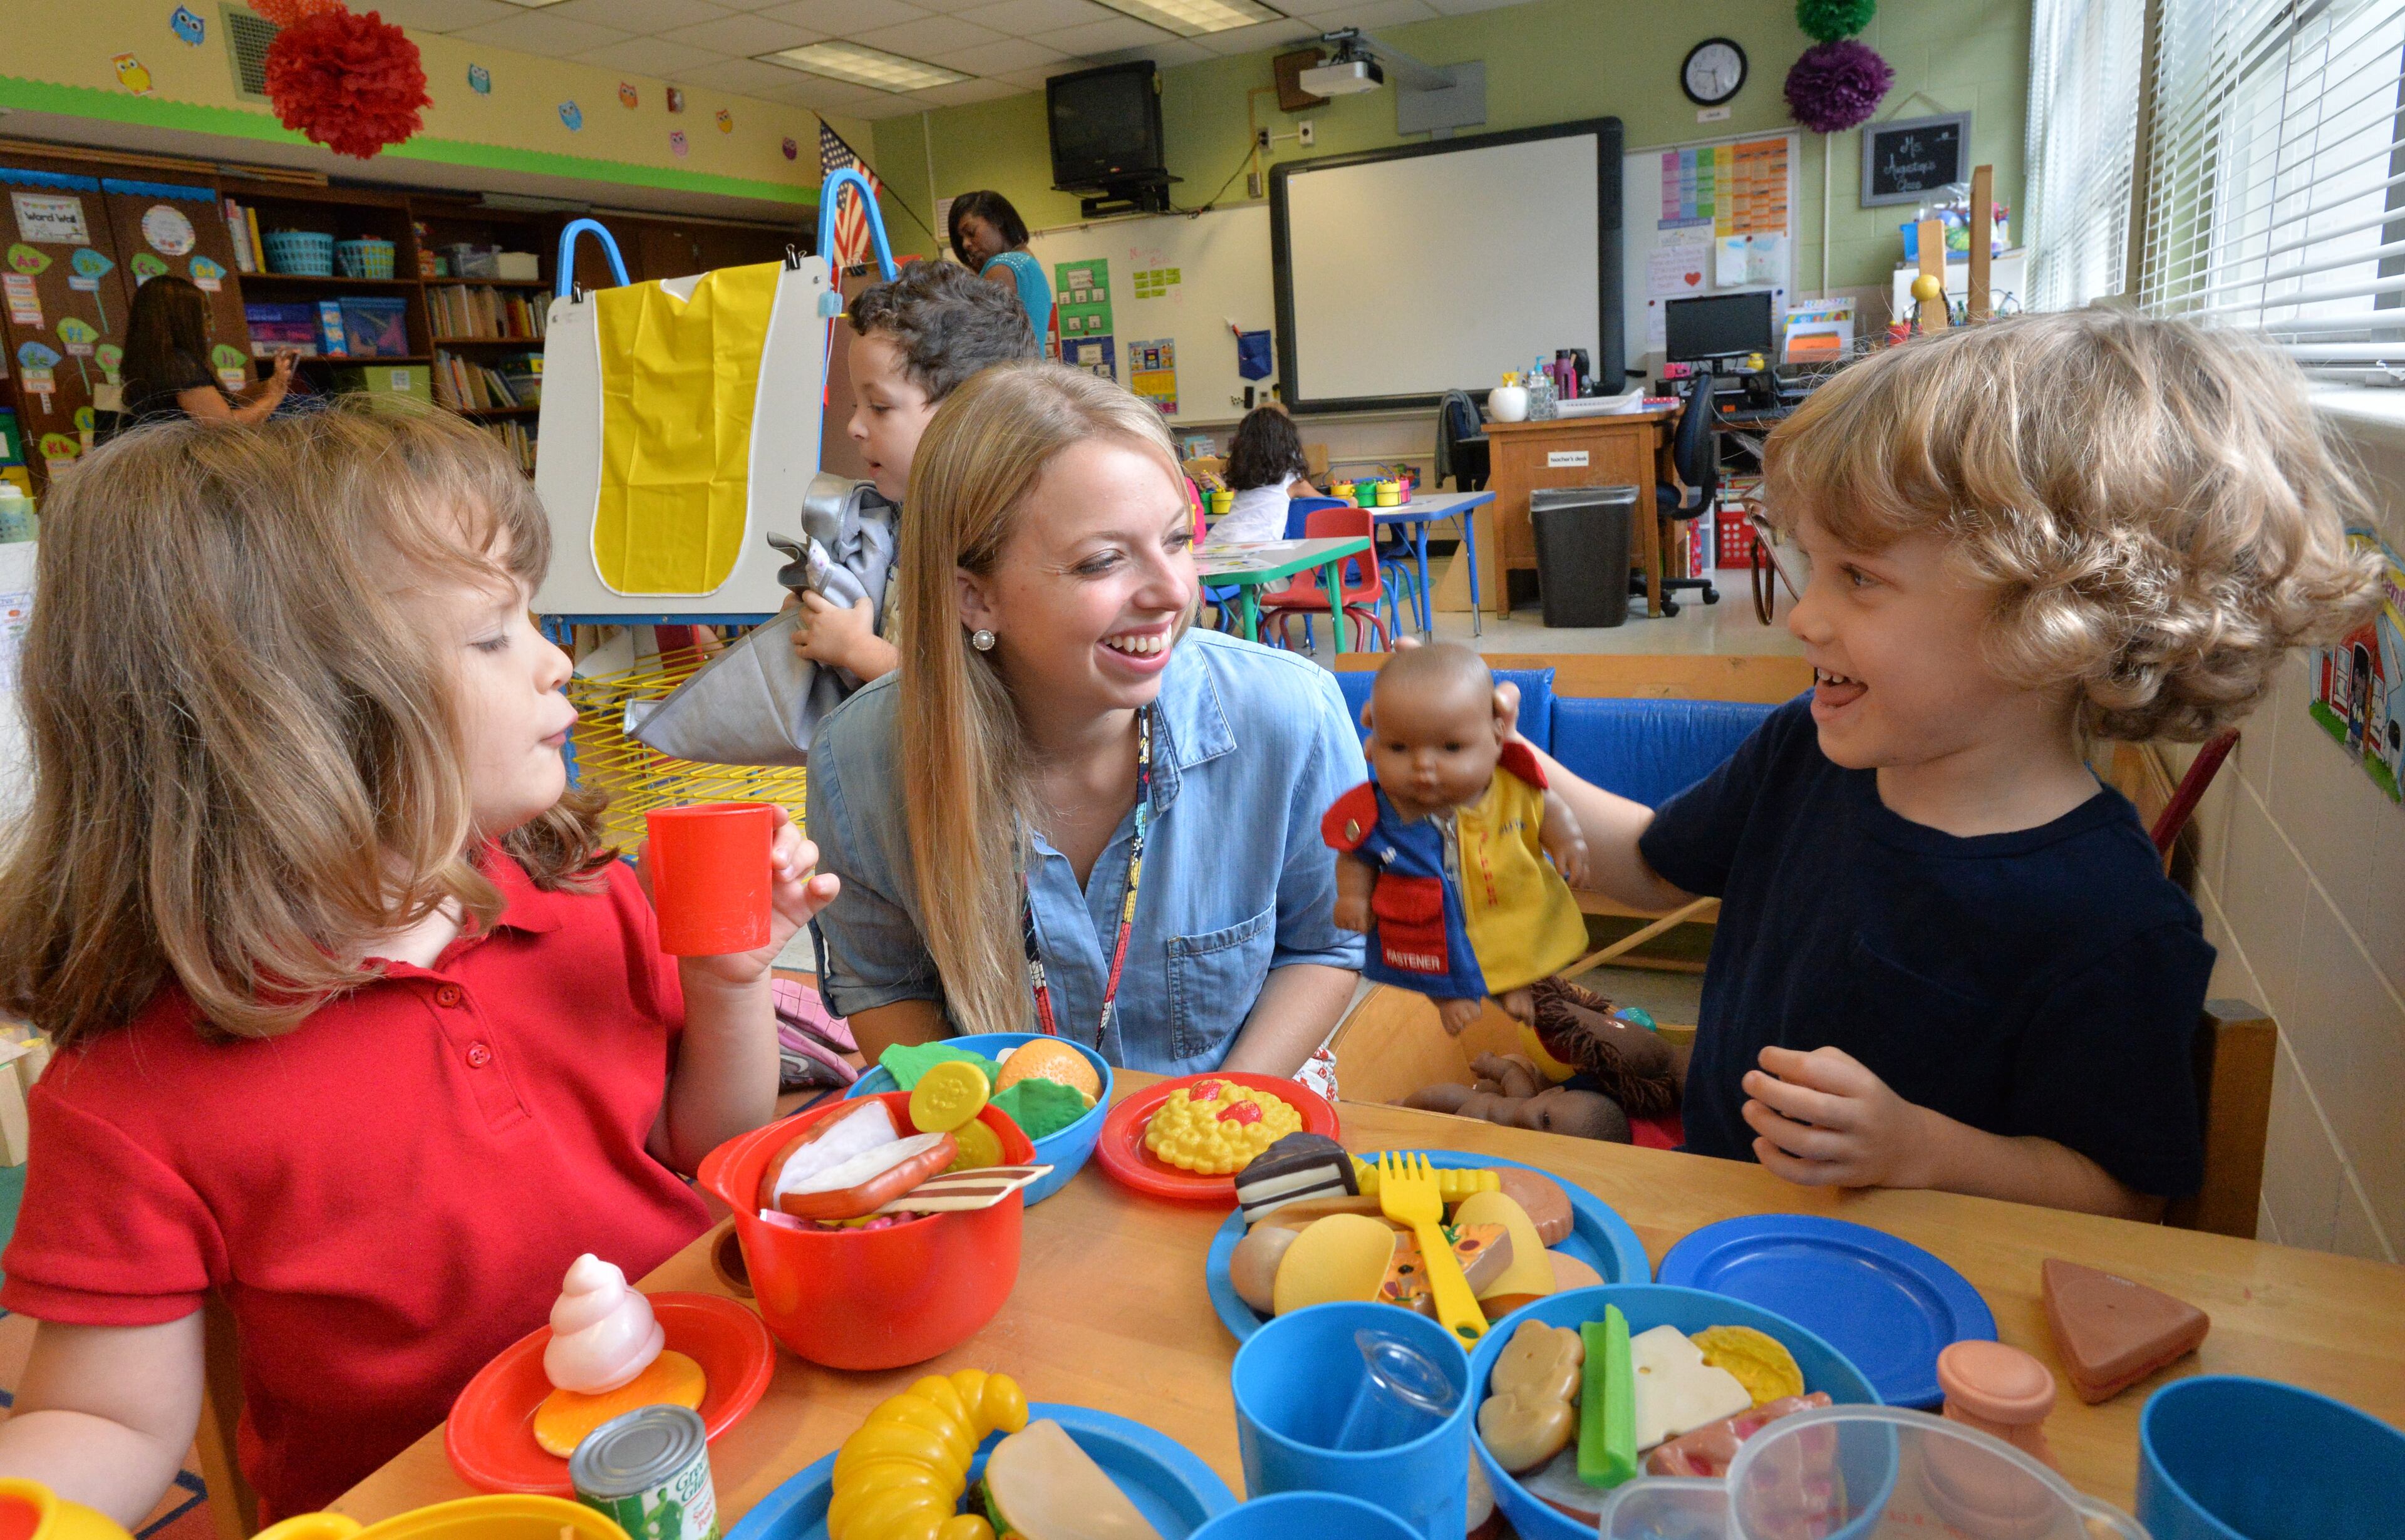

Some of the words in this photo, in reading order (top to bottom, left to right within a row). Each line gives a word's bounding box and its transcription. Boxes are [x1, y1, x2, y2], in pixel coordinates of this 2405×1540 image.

[24, 211, 54, 222] Word
[55, 213, 77, 224] Wall
[1385, 948, 1440, 971] FASTENER
